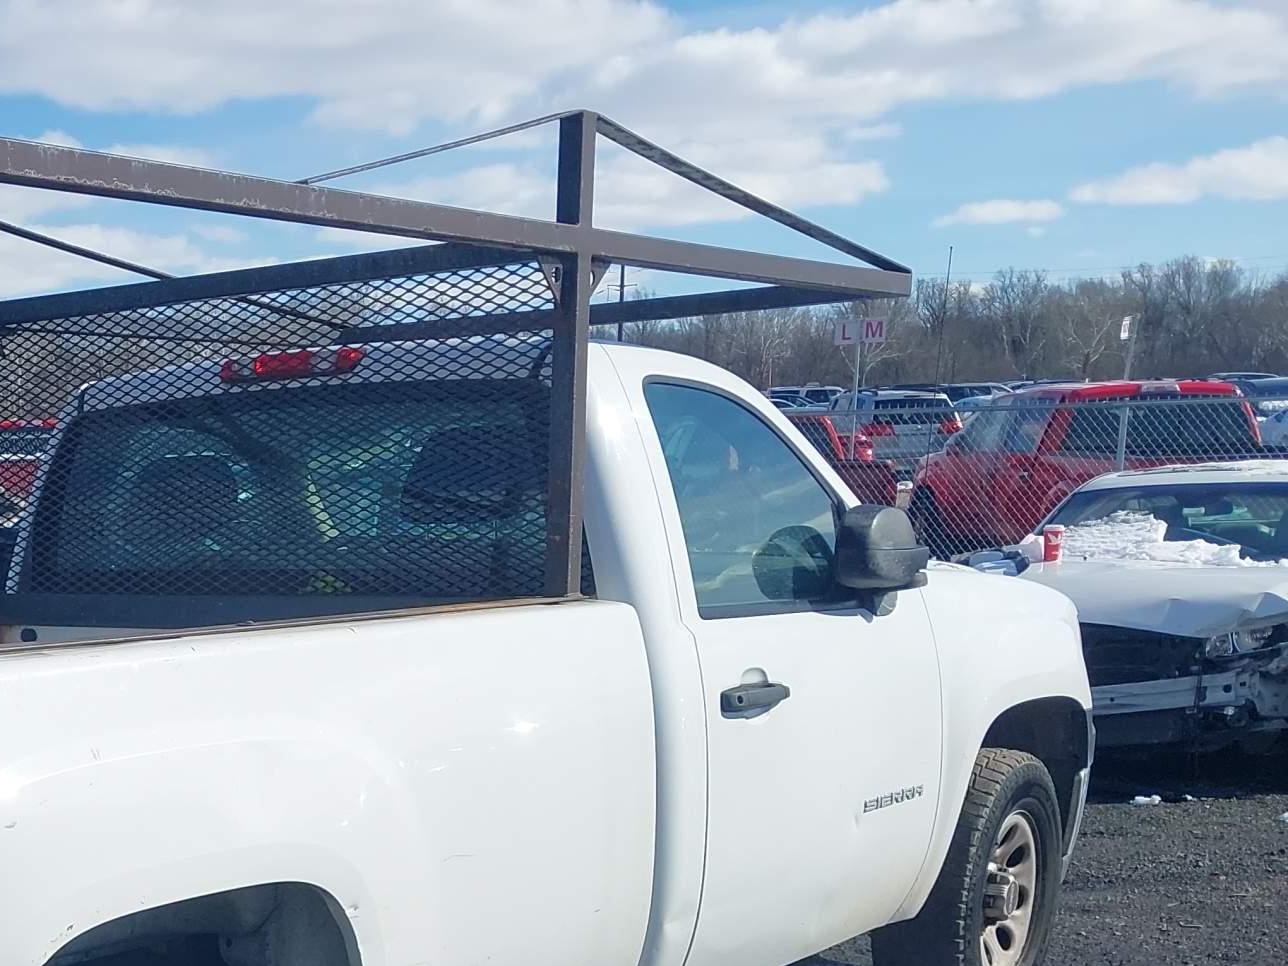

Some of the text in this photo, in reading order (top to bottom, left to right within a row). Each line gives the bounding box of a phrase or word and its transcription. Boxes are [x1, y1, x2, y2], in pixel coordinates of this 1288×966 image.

[841, 320, 884, 340] L M
[863, 784, 924, 813] SIERRA
